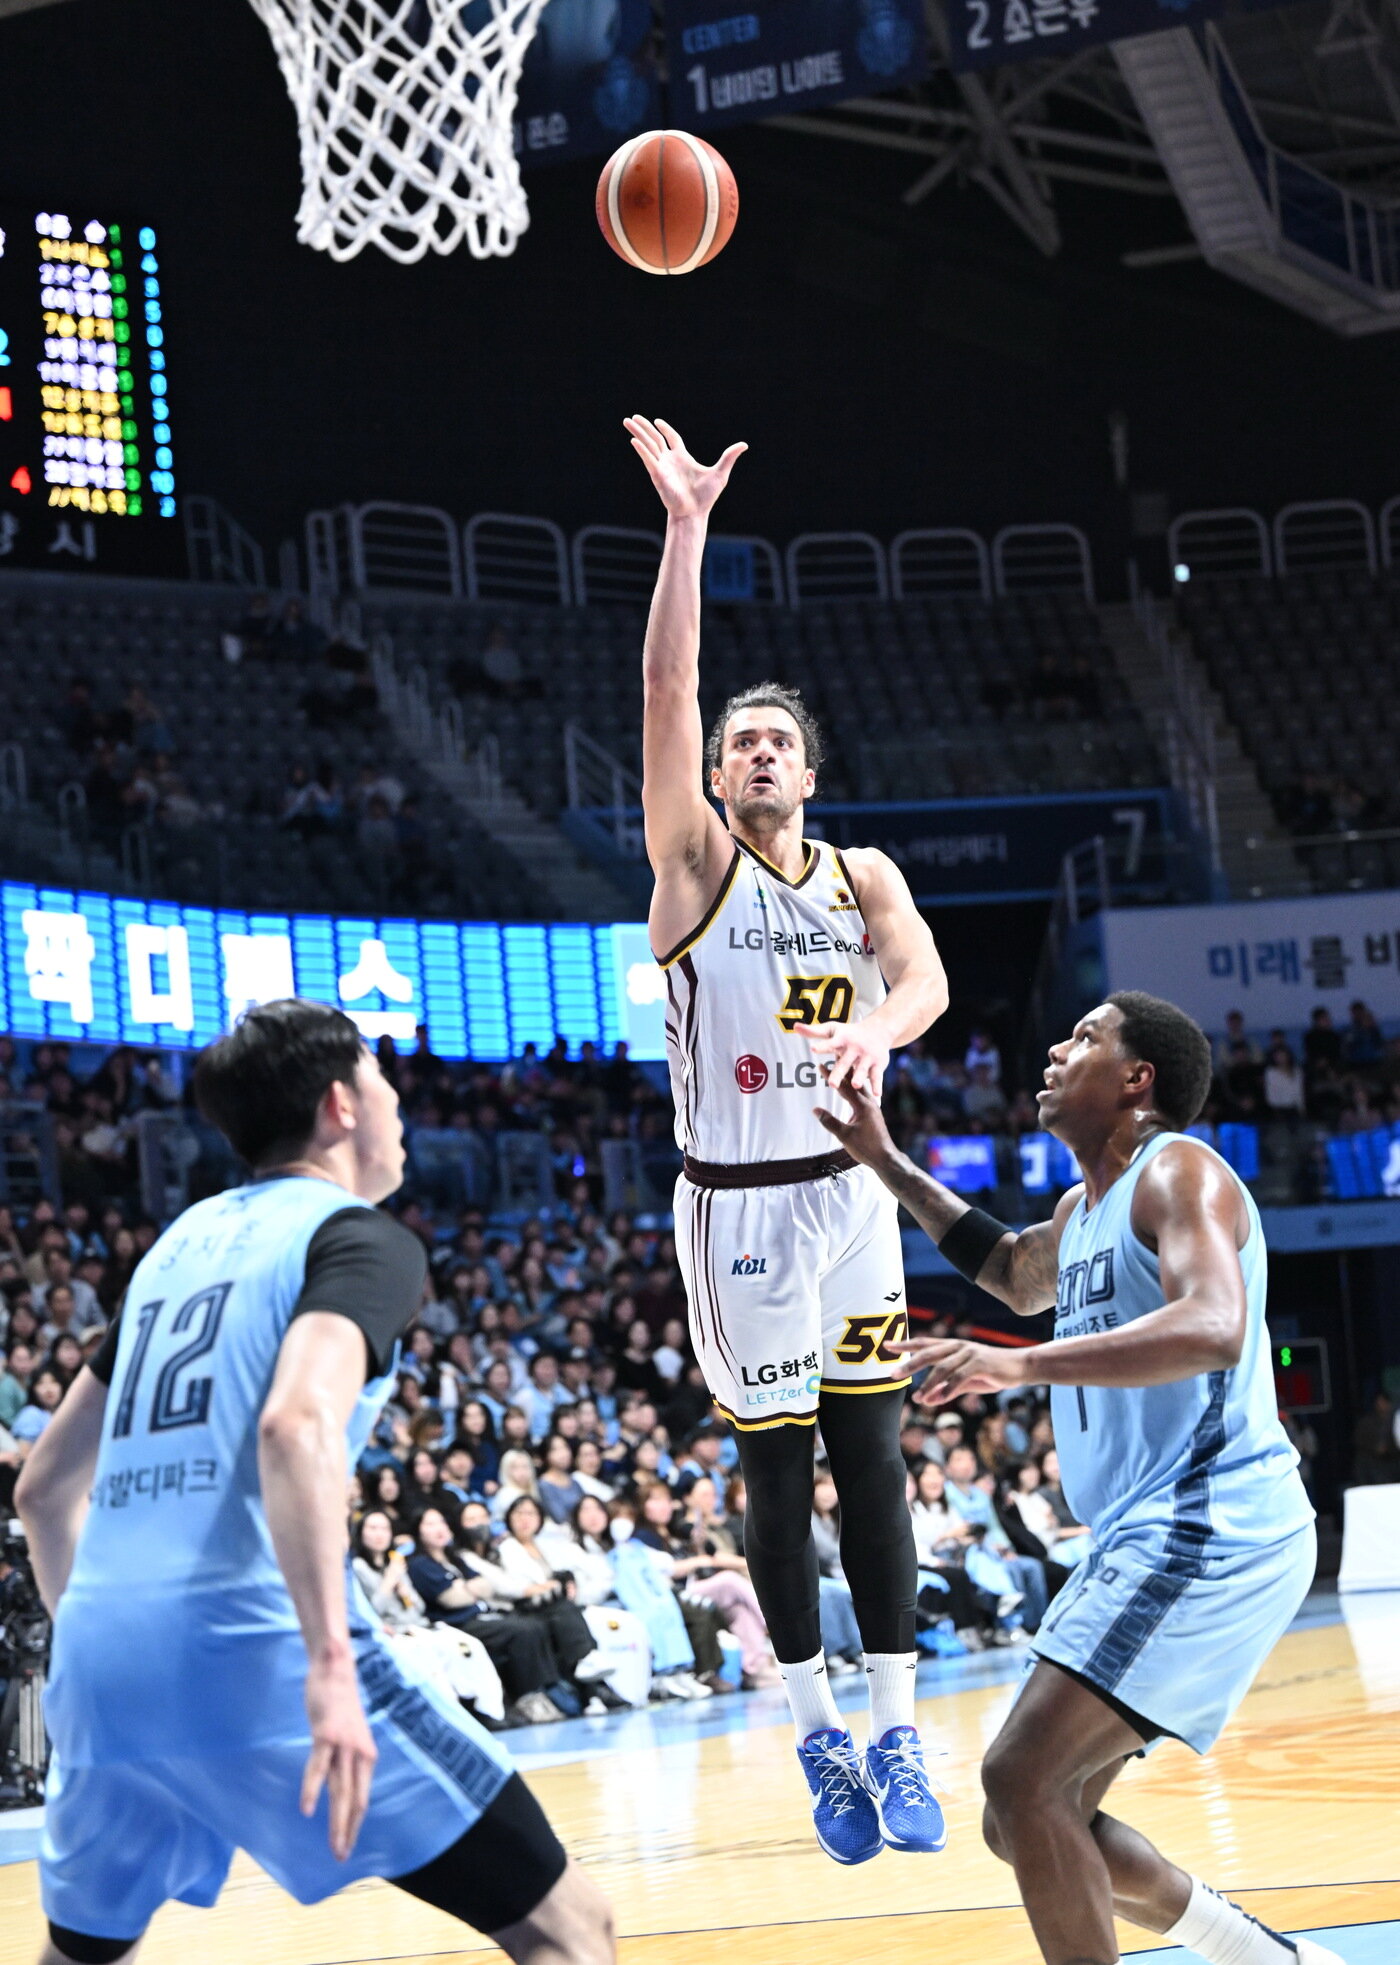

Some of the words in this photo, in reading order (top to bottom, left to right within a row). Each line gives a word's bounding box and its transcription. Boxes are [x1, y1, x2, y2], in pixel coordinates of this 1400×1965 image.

[774, 974, 856, 1034] 50
[731, 1254, 767, 1275] KBL
[113, 1281, 234, 1439] 12
[832, 1312, 907, 1366] 50
